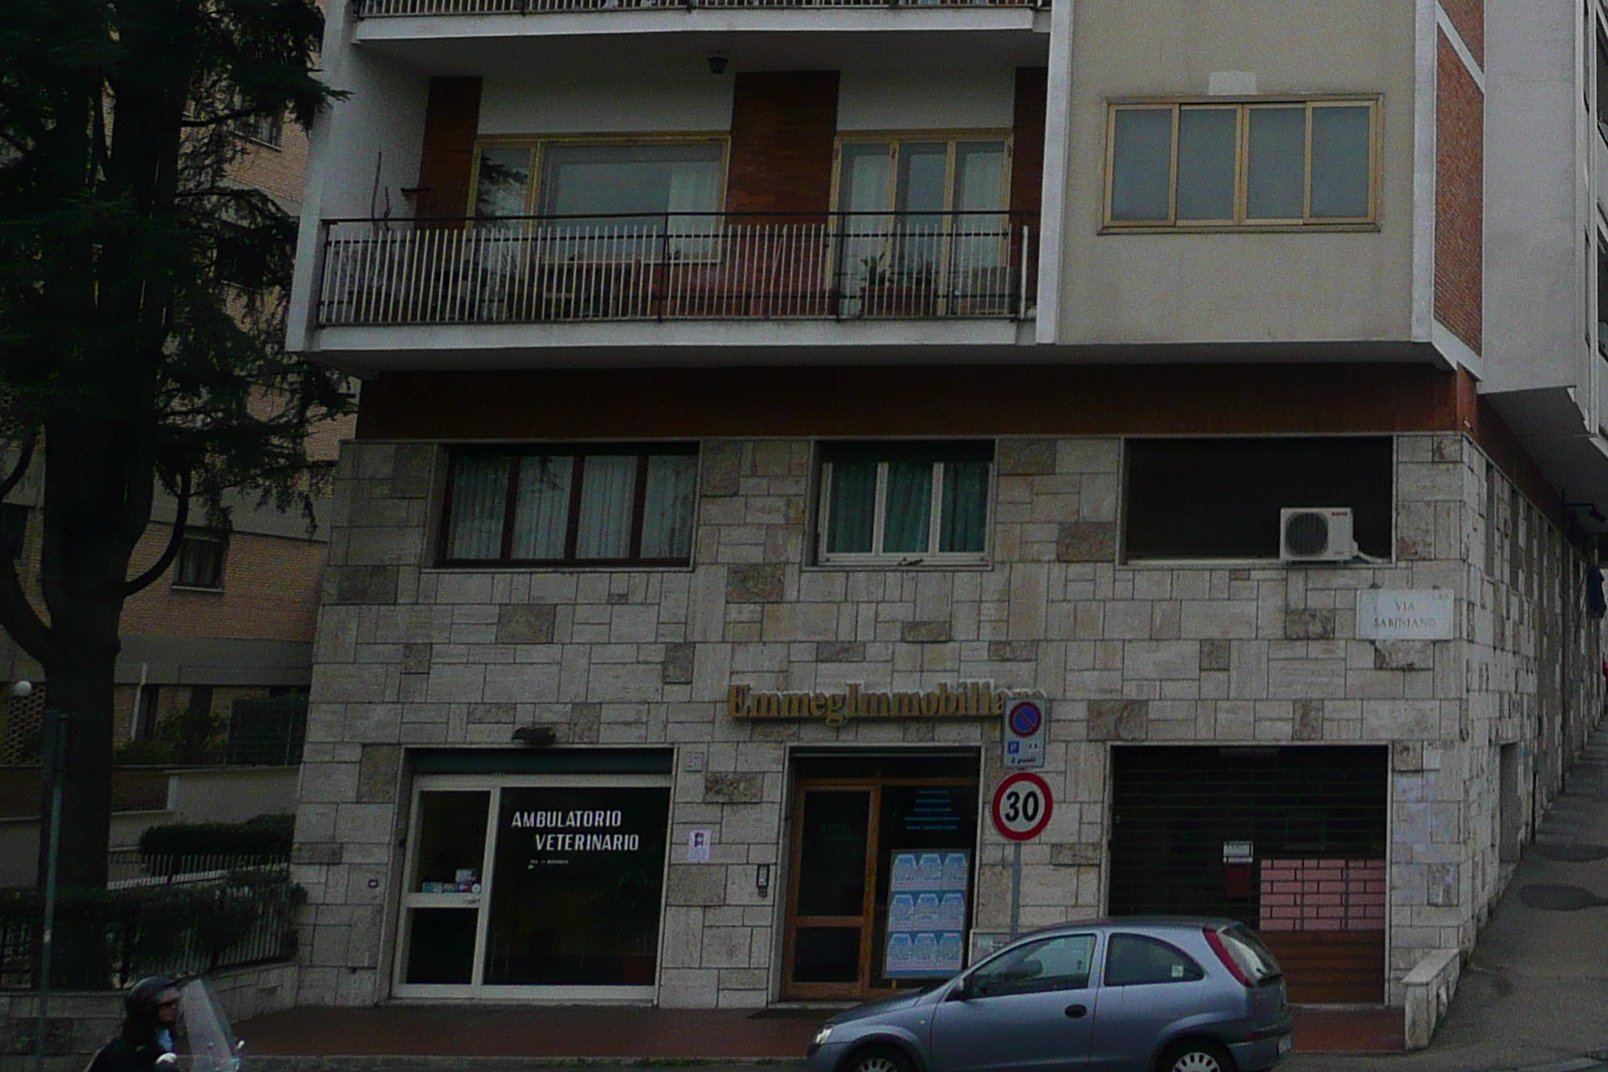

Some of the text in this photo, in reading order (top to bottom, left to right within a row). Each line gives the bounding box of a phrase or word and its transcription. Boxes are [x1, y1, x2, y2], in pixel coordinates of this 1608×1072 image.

[1394, 600, 1416, 612] VIA
[1005, 790, 1040, 822] 30
[511, 810, 622, 828] AMBULATORIO
[535, 833, 640, 851] VETERINARIO
